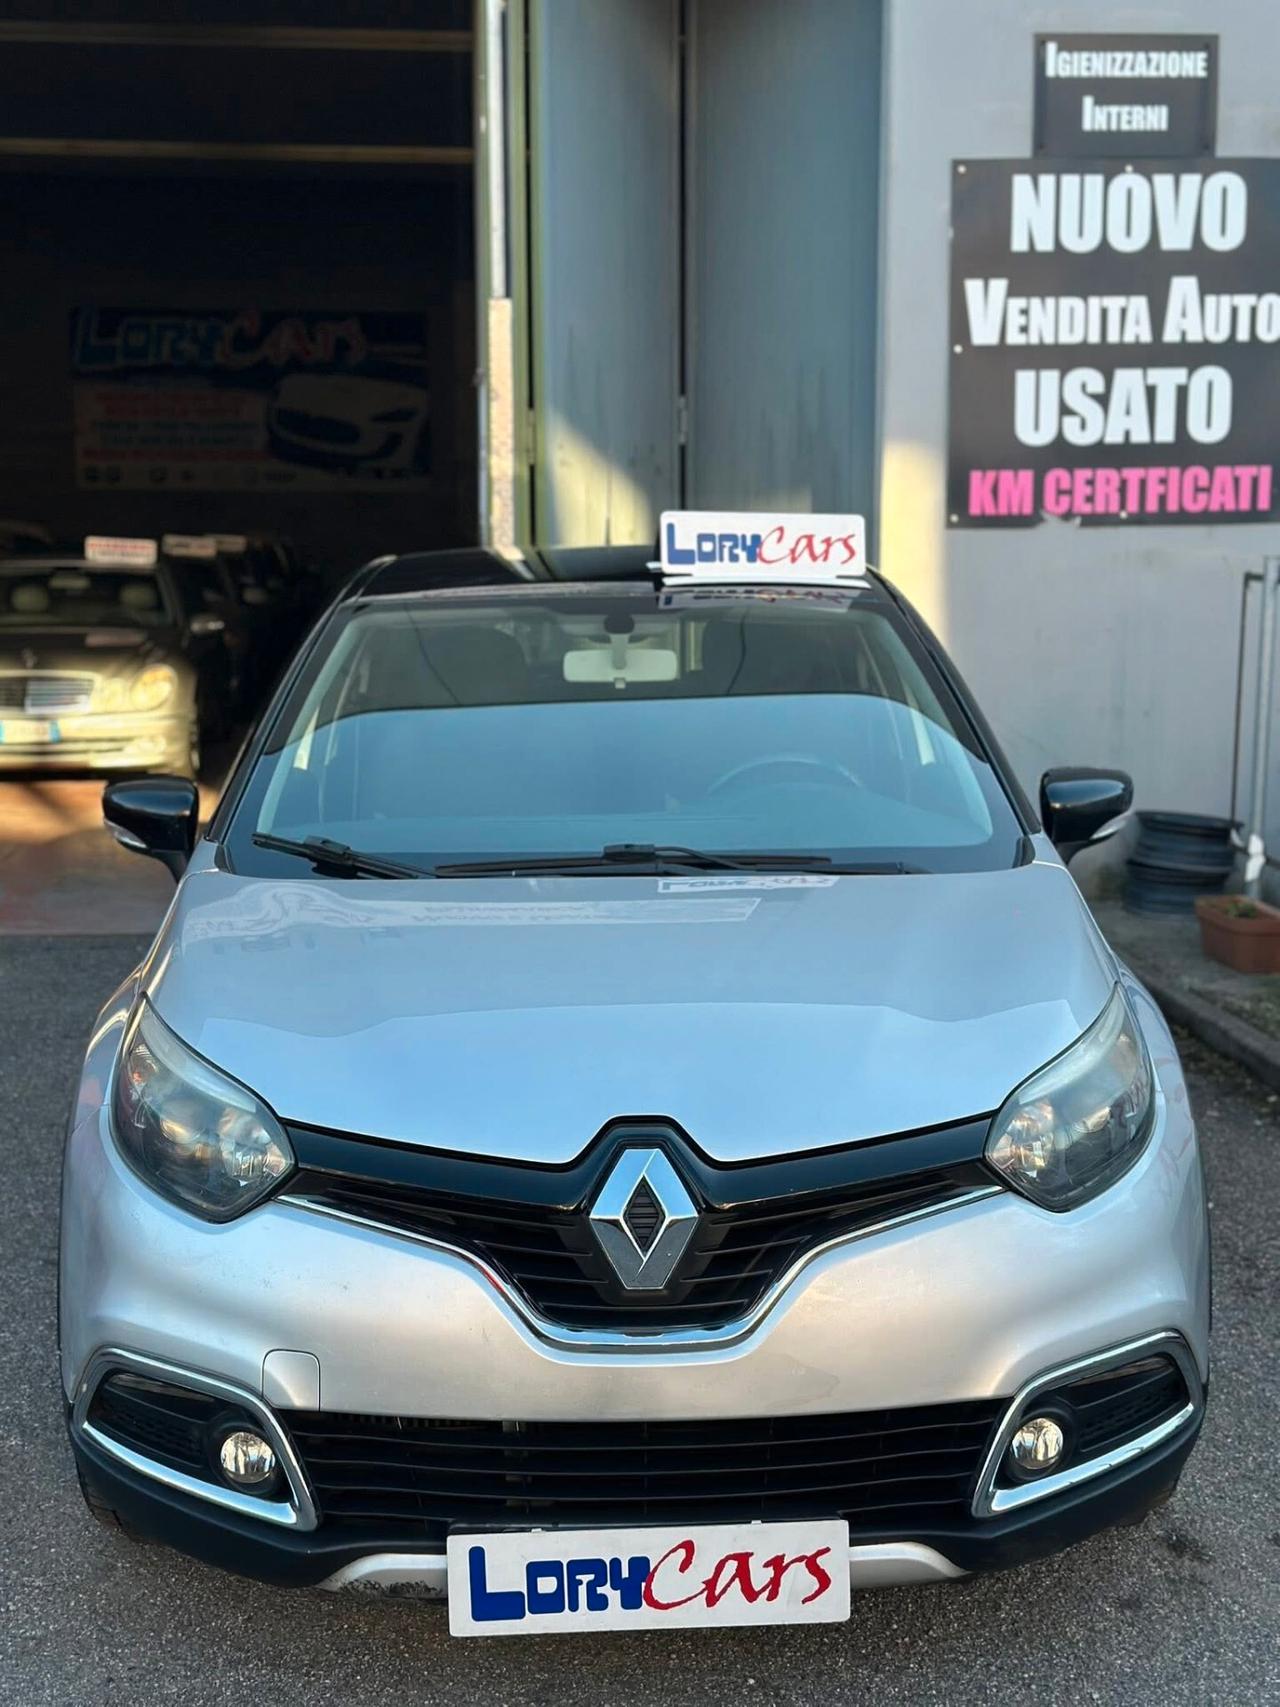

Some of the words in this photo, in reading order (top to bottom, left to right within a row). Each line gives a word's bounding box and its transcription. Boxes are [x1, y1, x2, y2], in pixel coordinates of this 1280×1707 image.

[1045, 41, 1207, 80] IGIENIZZAZIONE
[1082, 95, 1169, 132] INTERNI
[1010, 171, 1248, 254] NUOVO
[964, 277, 1152, 346] VENDITA
[1163, 275, 1280, 344] AUTO
[1014, 365, 1233, 447] USATO
[968, 469, 1034, 516] KM
[1043, 464, 1272, 518] CERTFICATI
